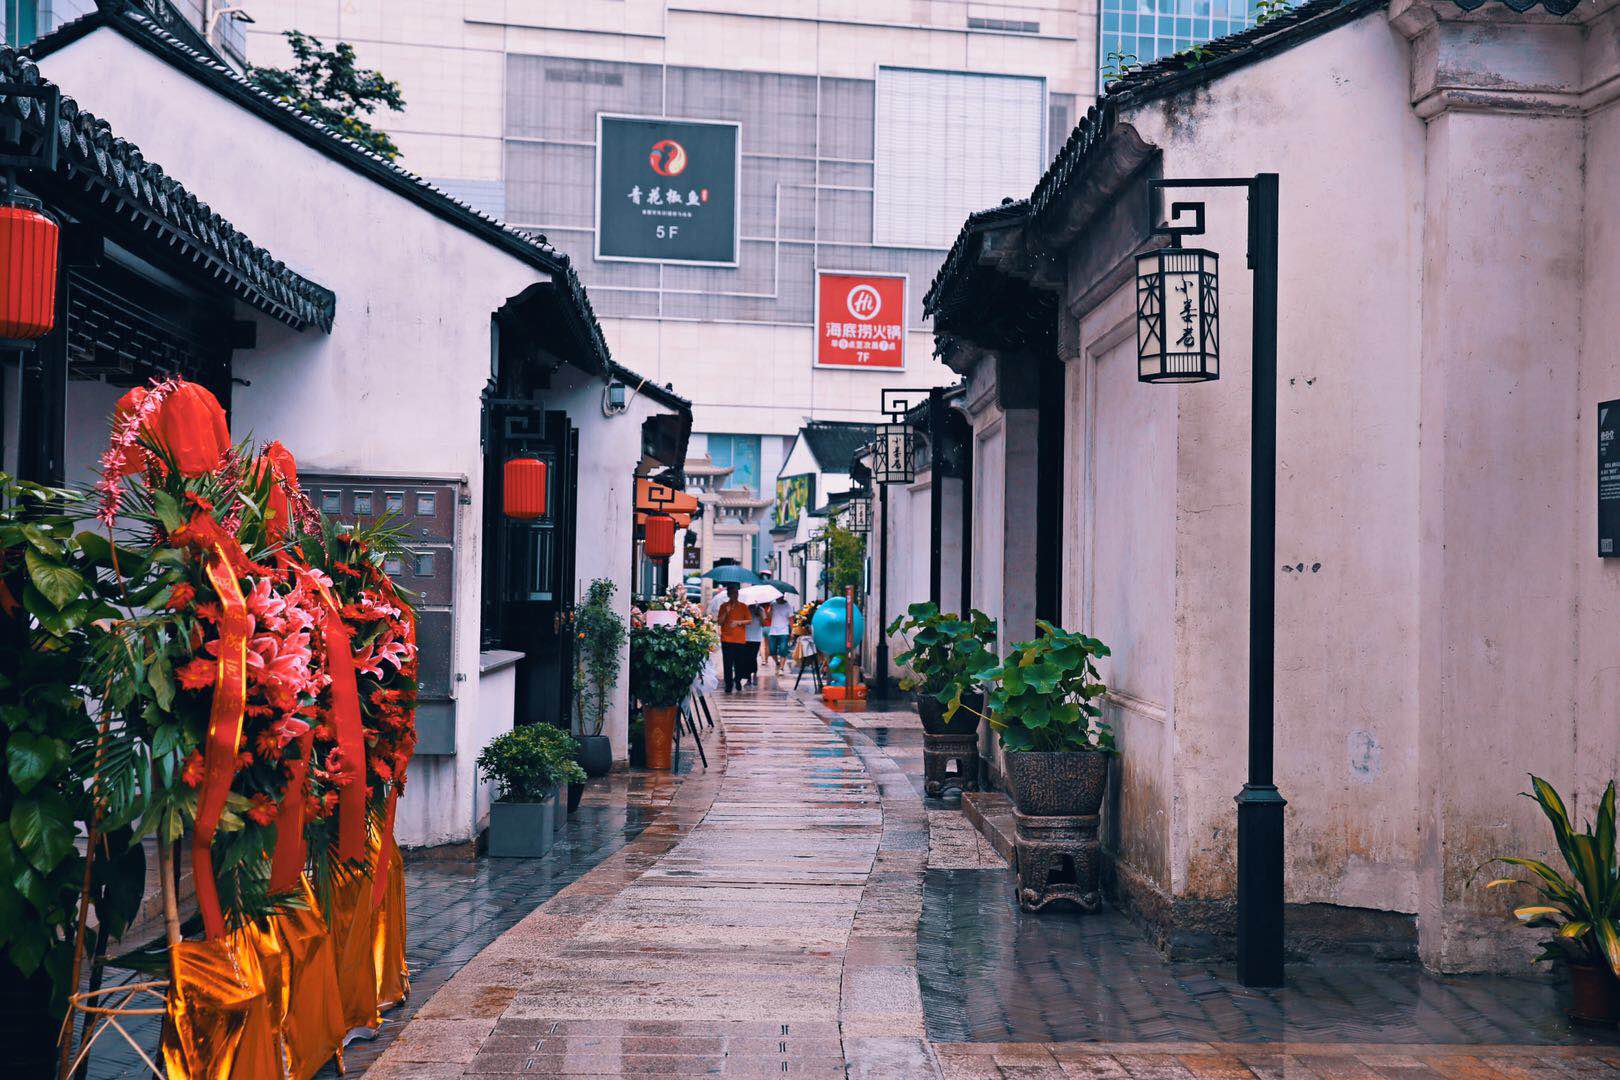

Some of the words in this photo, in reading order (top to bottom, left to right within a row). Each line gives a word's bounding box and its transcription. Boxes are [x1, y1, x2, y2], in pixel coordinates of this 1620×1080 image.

[627, 185, 701, 206] 青花椒鱼
[656, 225, 679, 239] 5F
[825, 322, 901, 340] 海底捞火锅
[857, 351, 870, 363] 7F
